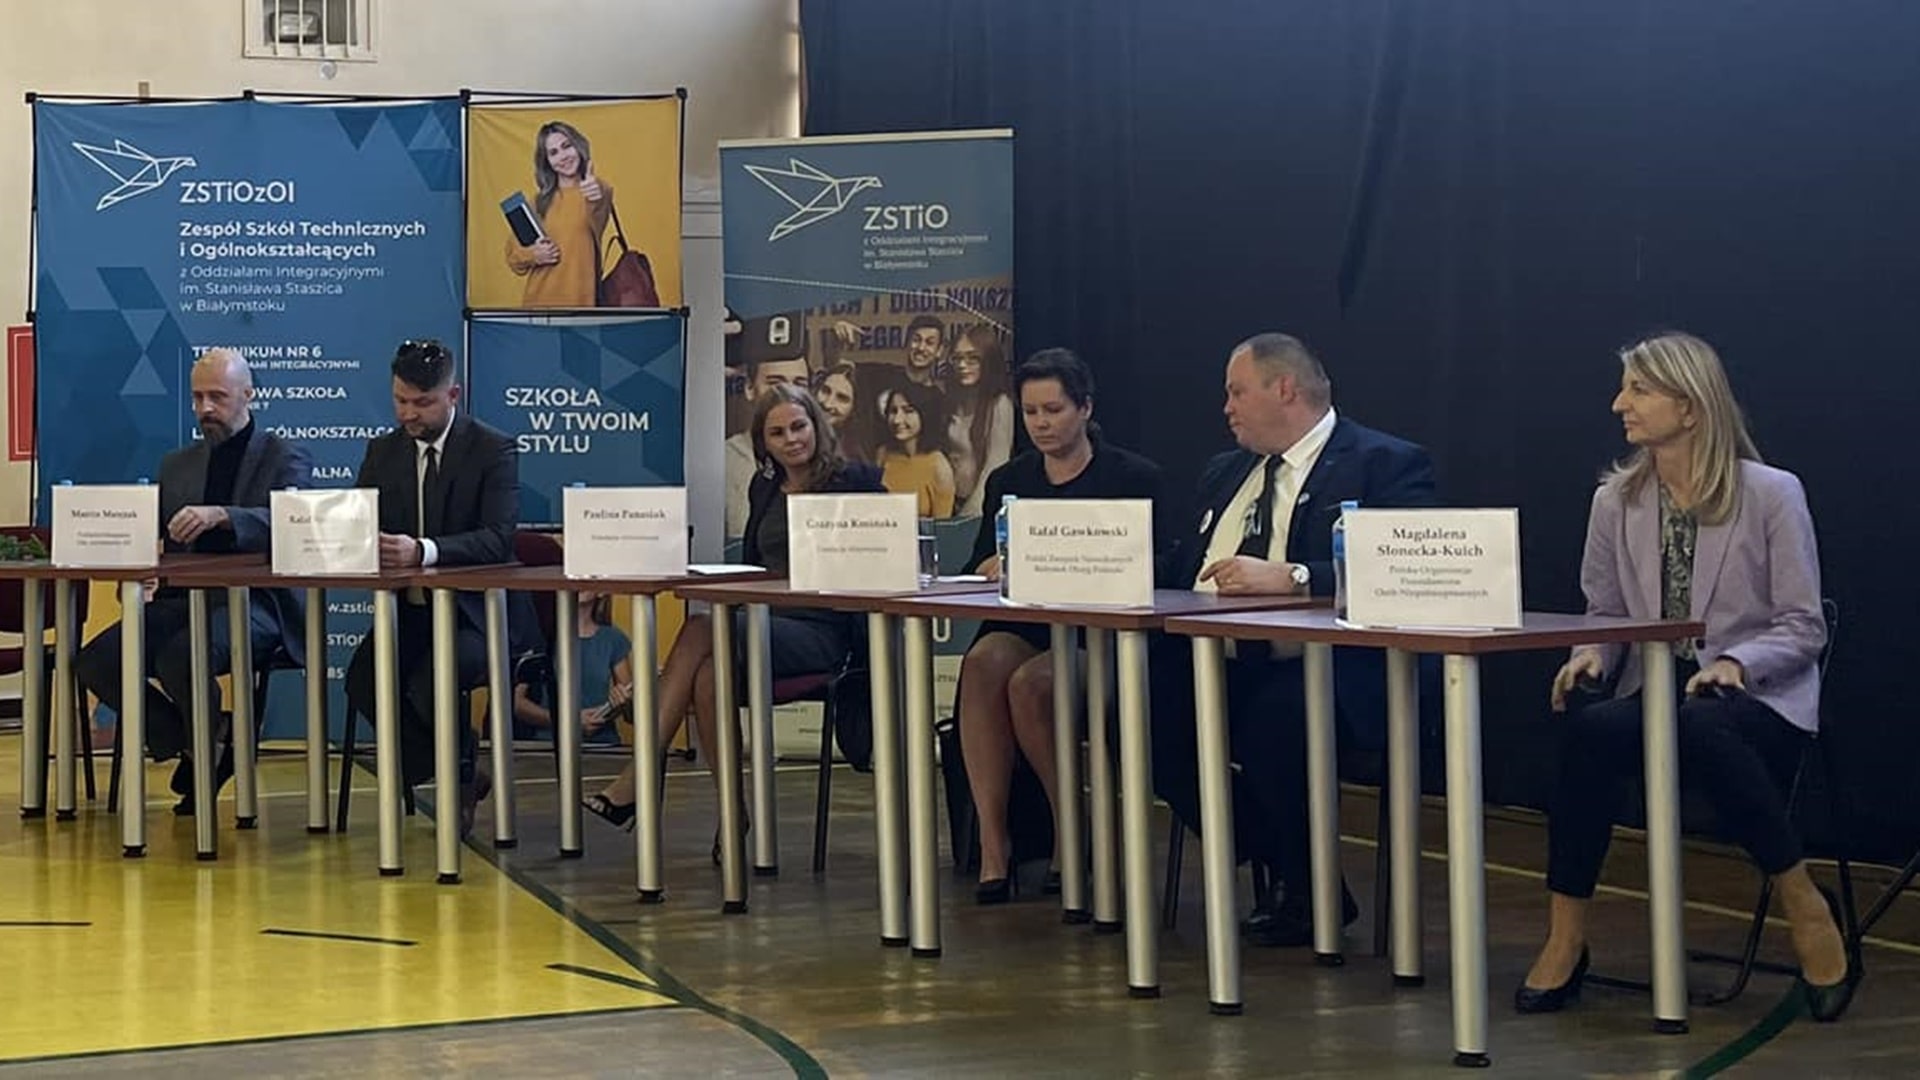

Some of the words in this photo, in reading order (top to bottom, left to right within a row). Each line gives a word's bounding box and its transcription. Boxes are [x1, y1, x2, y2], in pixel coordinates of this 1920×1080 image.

[863, 204, 949, 230] ZSTiO
[179, 221, 241, 239] Zespół
[246, 221, 294, 236] Szkół
[299, 220, 426, 239] Technicznych
[180, 242, 185, 257] i
[190, 242, 375, 260] Ogólnokształcących
[180, 269, 187, 277] z
[191, 265, 272, 277] Oddziałami
[277, 265, 384, 280] Integracyjnymi
[180, 282, 200, 294] im.
[205, 281, 281, 294] Stanisława
[286, 281, 343, 294] Staszica
[180, 302, 193, 311] w
[196, 299, 285, 314] Białymstoku
[286, 346, 309, 358] NR
[312, 346, 322, 358] 6
[286, 386, 347, 399] SZKOŁA
[505, 387, 602, 406] SZKOŁA
[529, 412, 555, 431] W
[562, 411, 649, 431] TWOIM
[517, 434, 590, 453] STYLU
[1392, 527, 1466, 541] Magdalena
